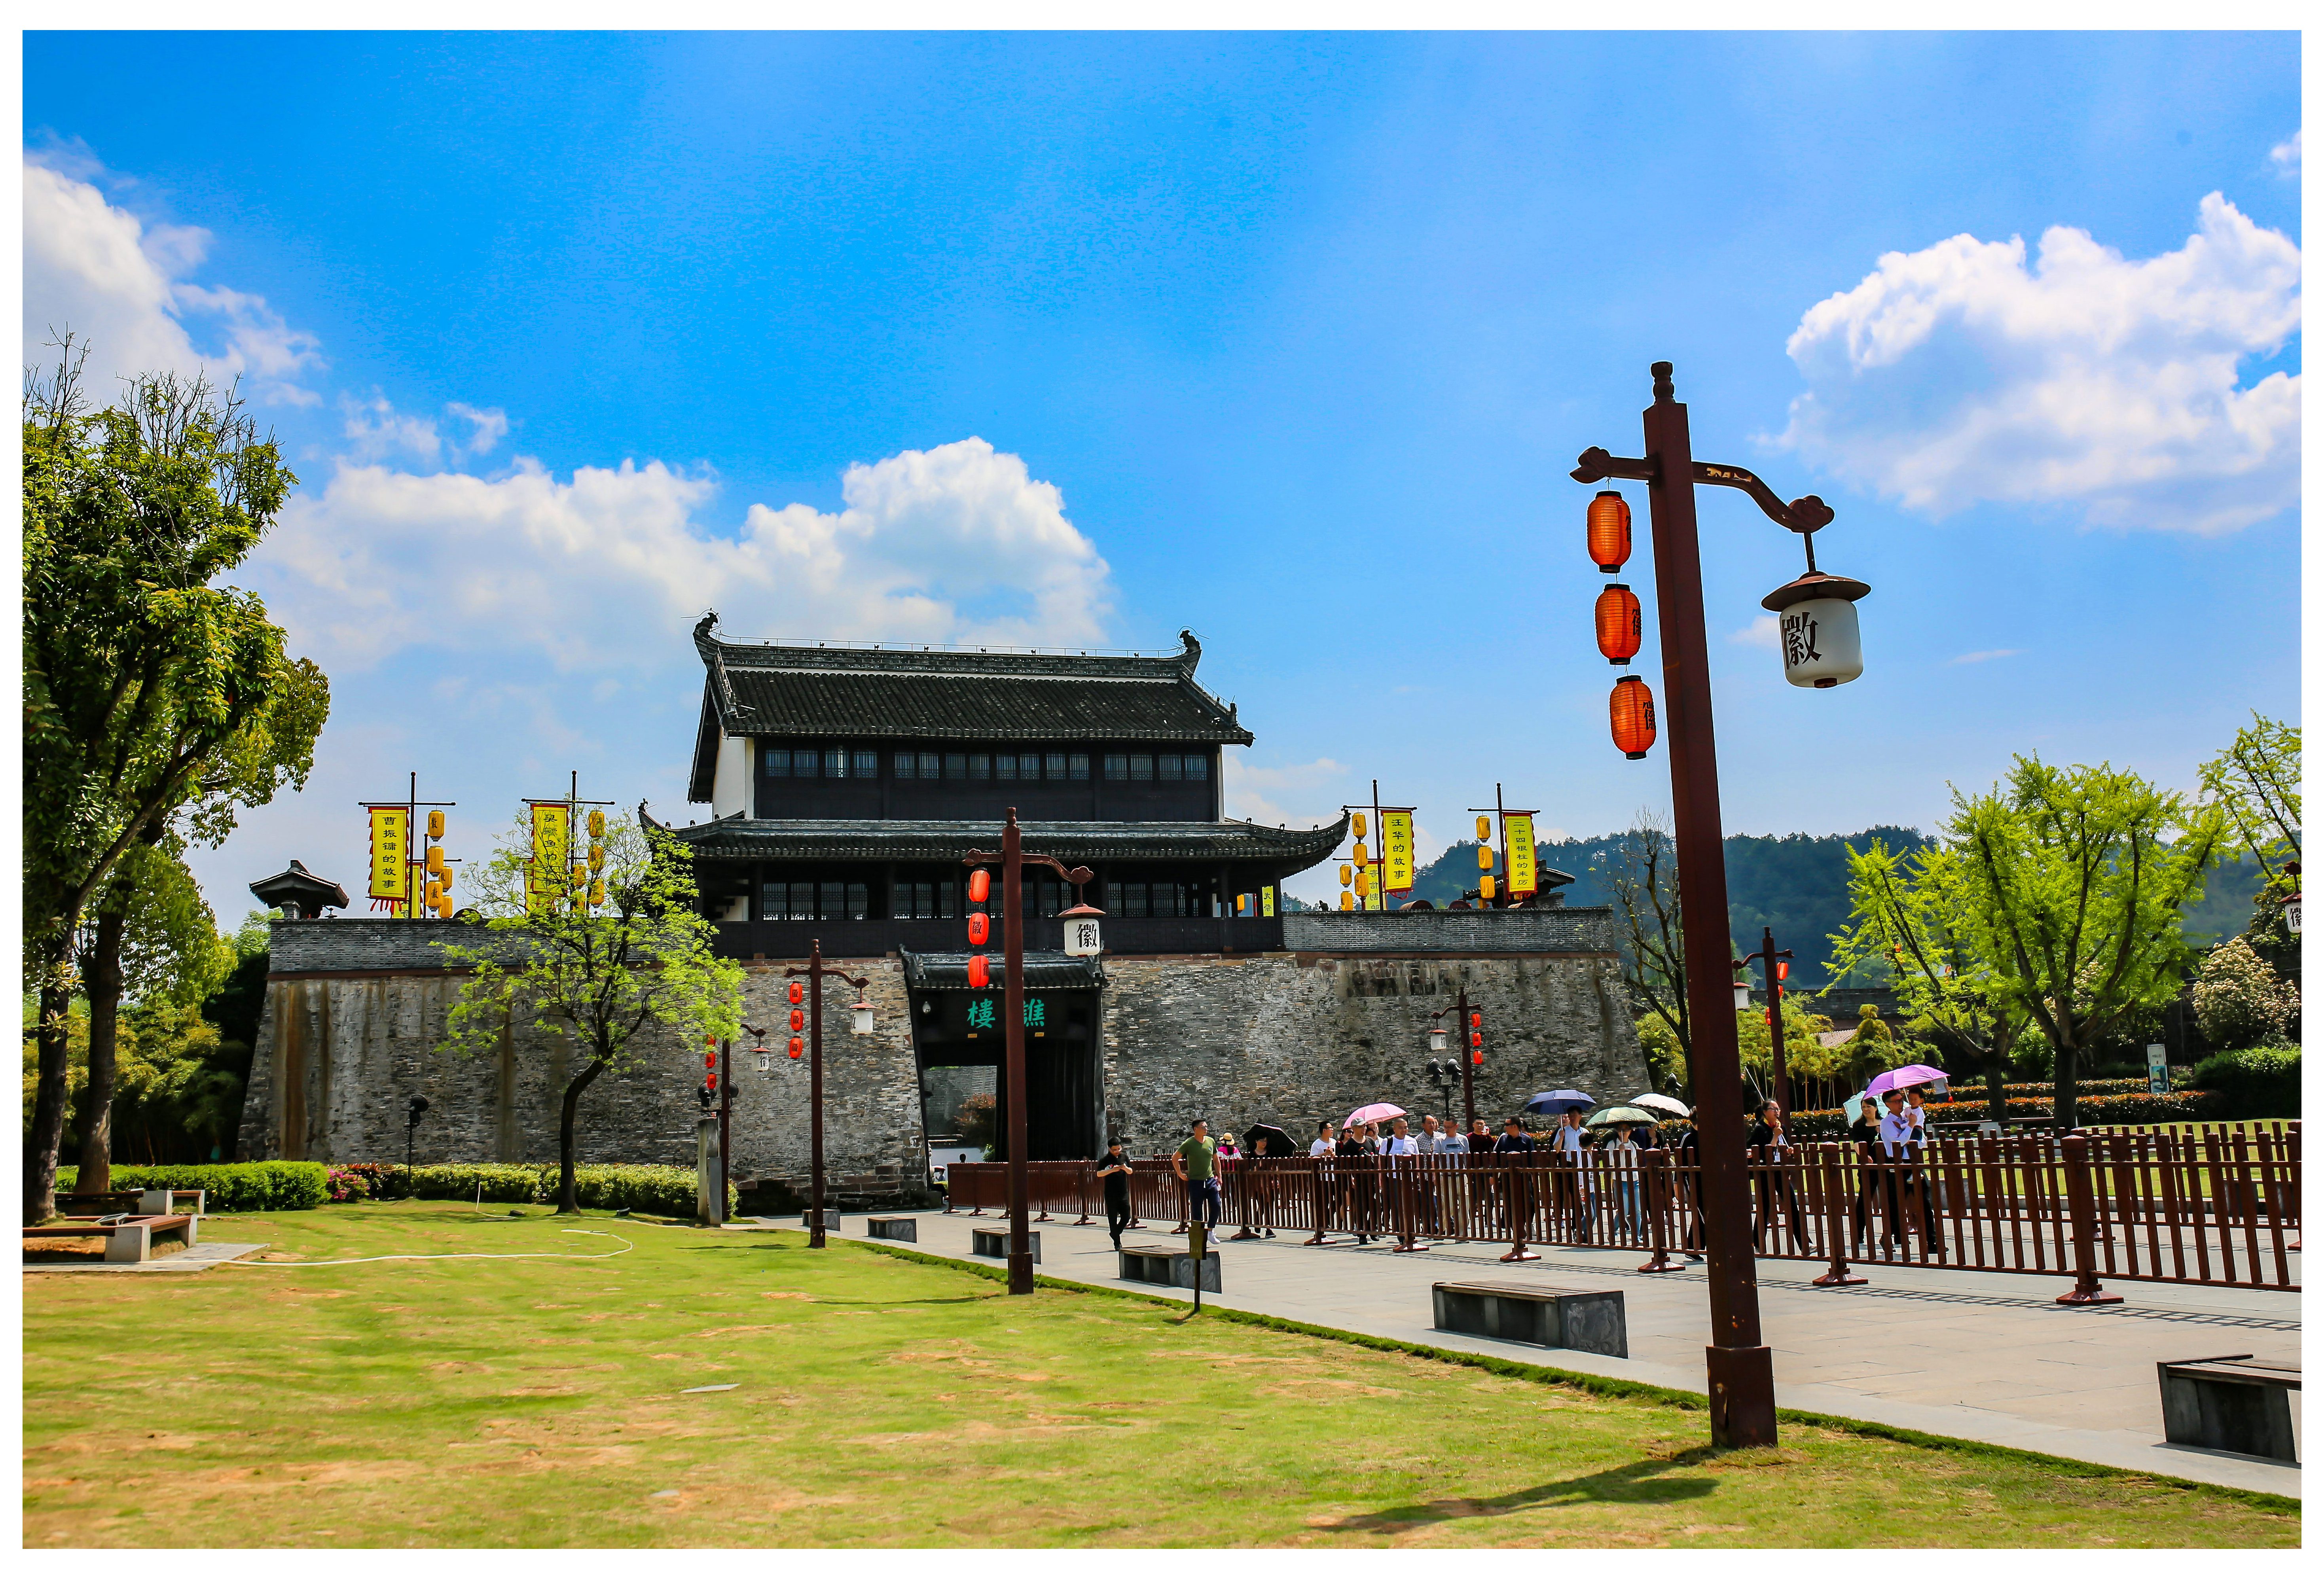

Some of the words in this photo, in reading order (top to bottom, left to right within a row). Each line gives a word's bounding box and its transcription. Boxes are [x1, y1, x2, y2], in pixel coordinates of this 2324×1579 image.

[1782, 612, 1822, 669] 徽
[382, 816, 397, 888] 曹振镛的故事
[1392, 819, 1405, 879] 汪华的故事
[1513, 822, 1528, 885] 二十四根柱的来历
[972, 921, 982, 934] 徽
[1077, 924, 1097, 947] 徽
